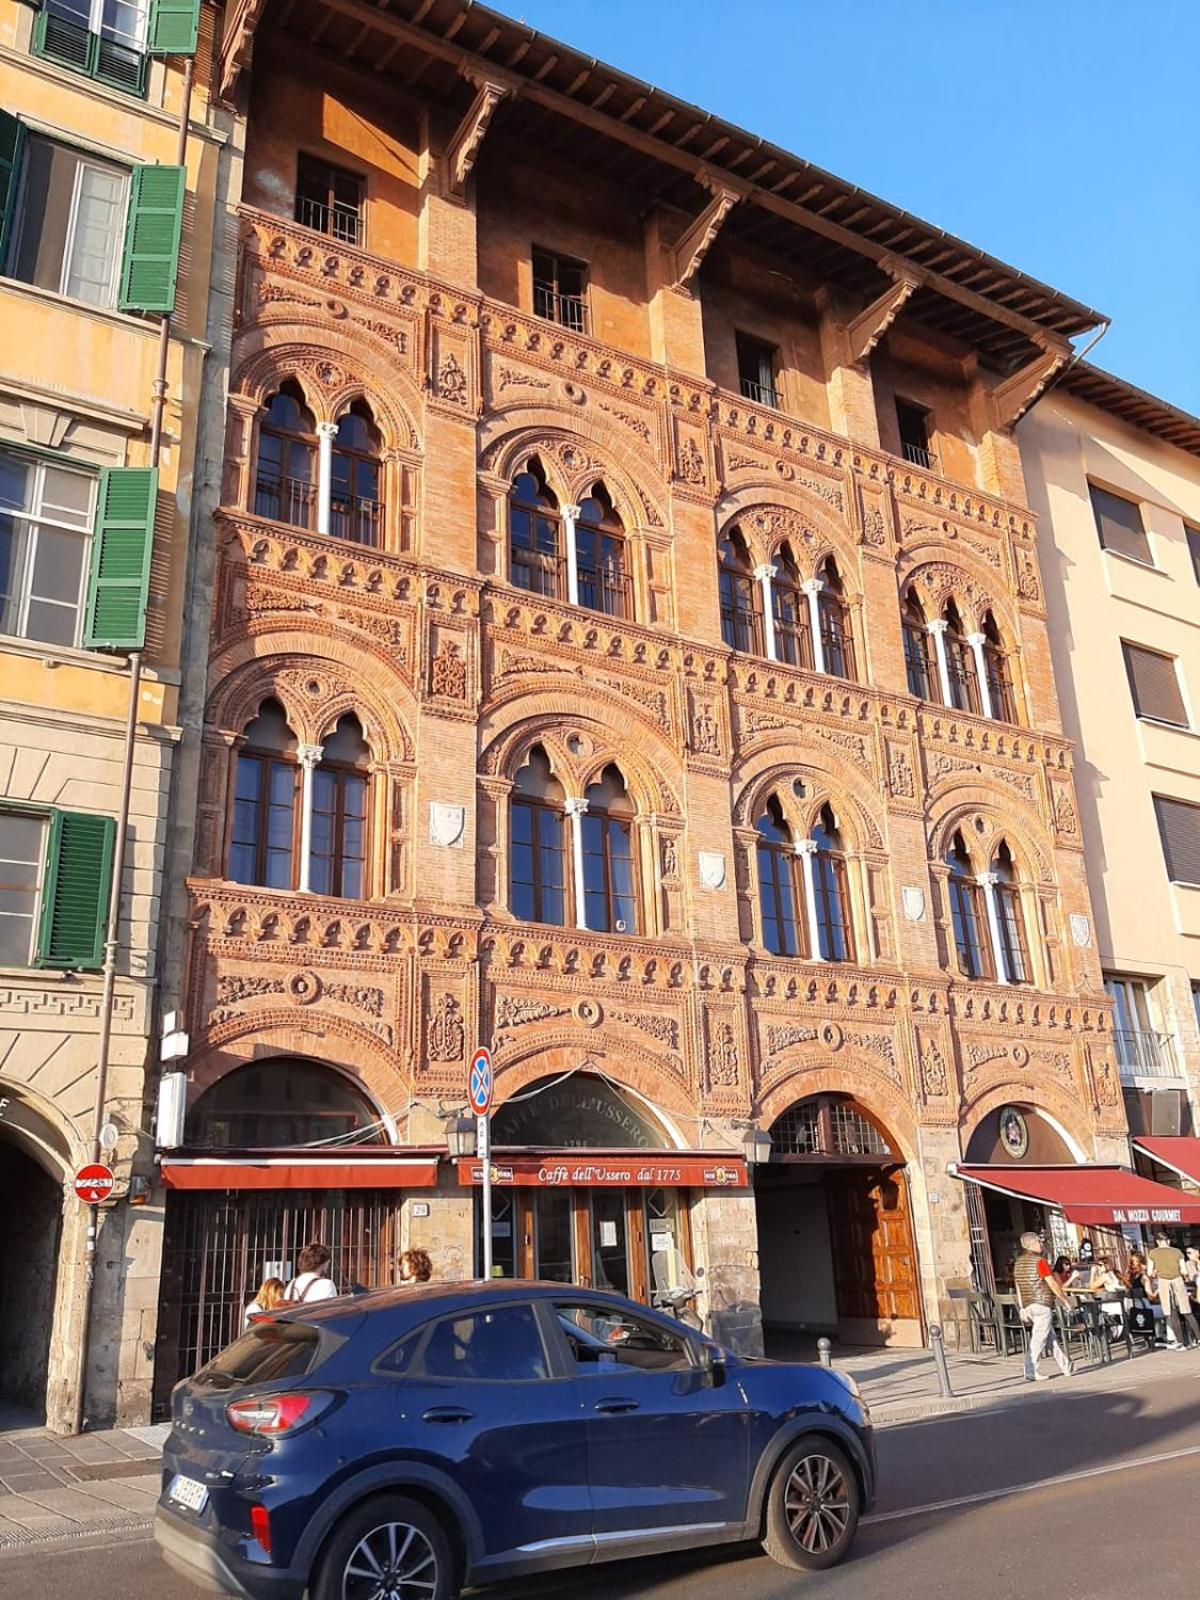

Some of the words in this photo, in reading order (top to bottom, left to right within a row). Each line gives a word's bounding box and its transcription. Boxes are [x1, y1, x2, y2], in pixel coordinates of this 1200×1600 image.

[637, 1167, 656, 1181] dal
[656, 1169, 682, 1181] 1775
[1112, 1209, 1127, 1222] DAL
